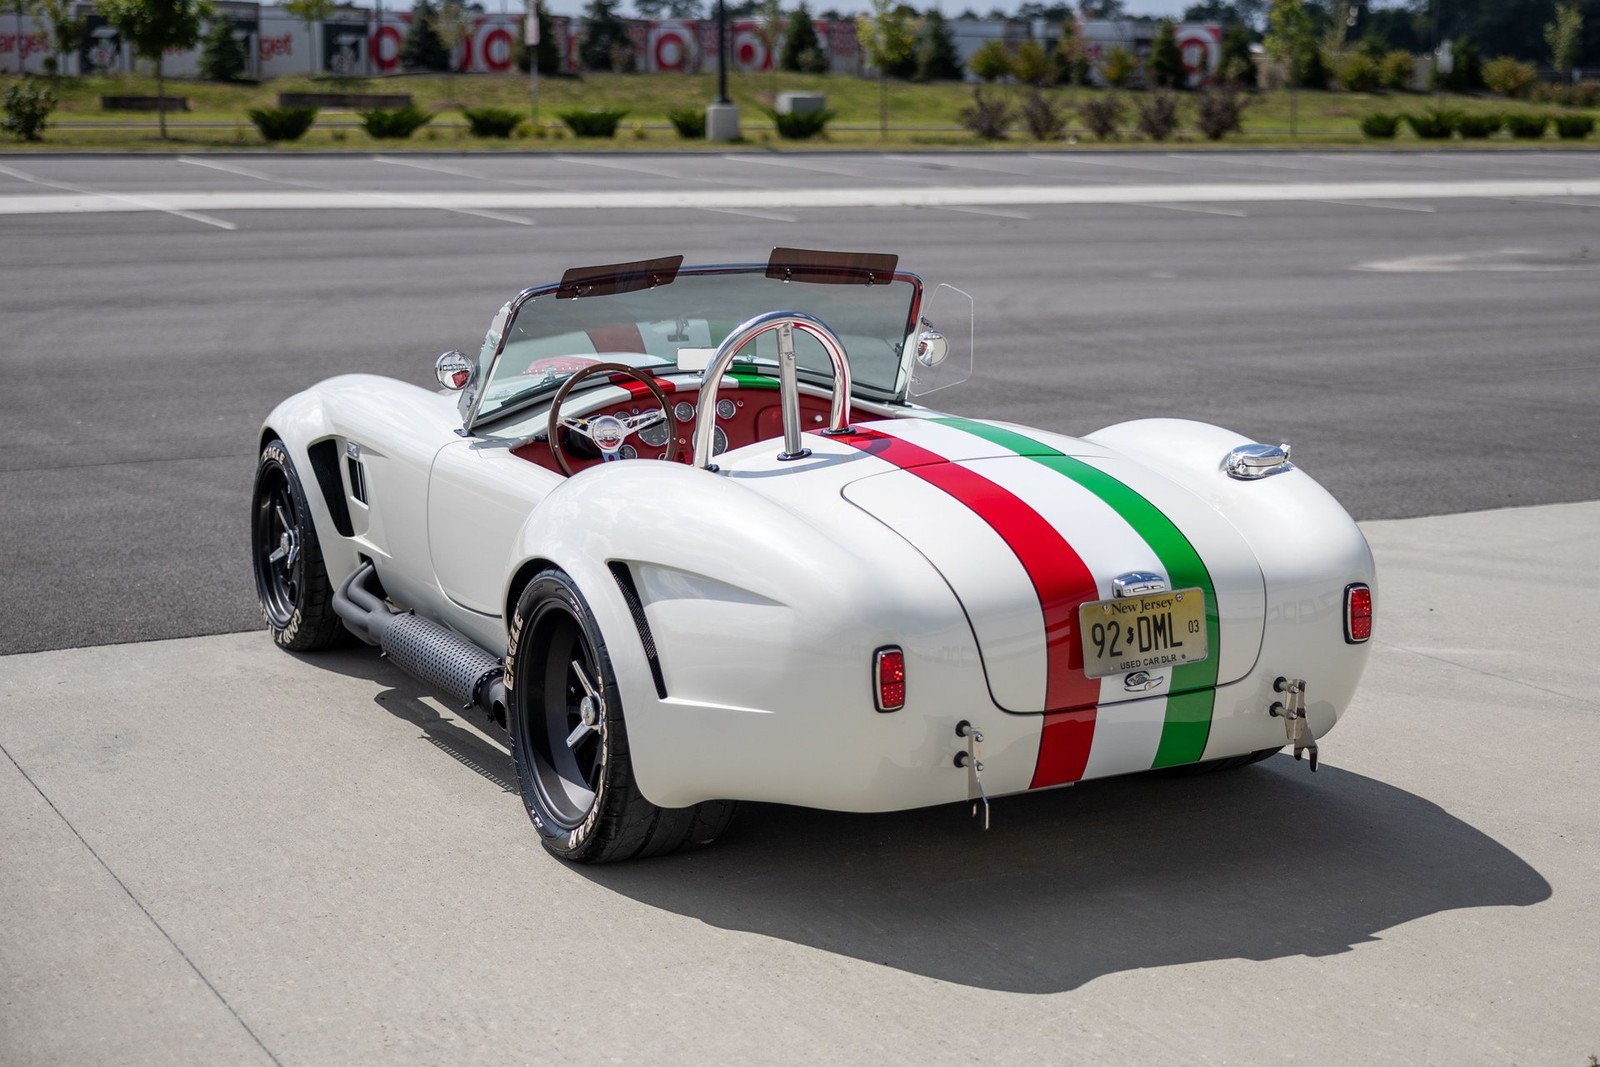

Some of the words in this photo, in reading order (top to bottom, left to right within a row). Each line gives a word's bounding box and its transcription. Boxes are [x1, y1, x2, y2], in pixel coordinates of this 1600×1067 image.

[260, 446, 286, 465] EAGLE
[1111, 603, 1138, 615] New
[1140, 598, 1174, 614] Jersey
[1092, 620, 1123, 659] 92
[1136, 612, 1183, 653] DML
[1188, 619, 1200, 634] 03
[503, 606, 524, 691] EAGLE
[1120, 659, 1142, 670] USED
[1143, 656, 1160, 666] CAR
[1161, 653, 1177, 664] DLR
